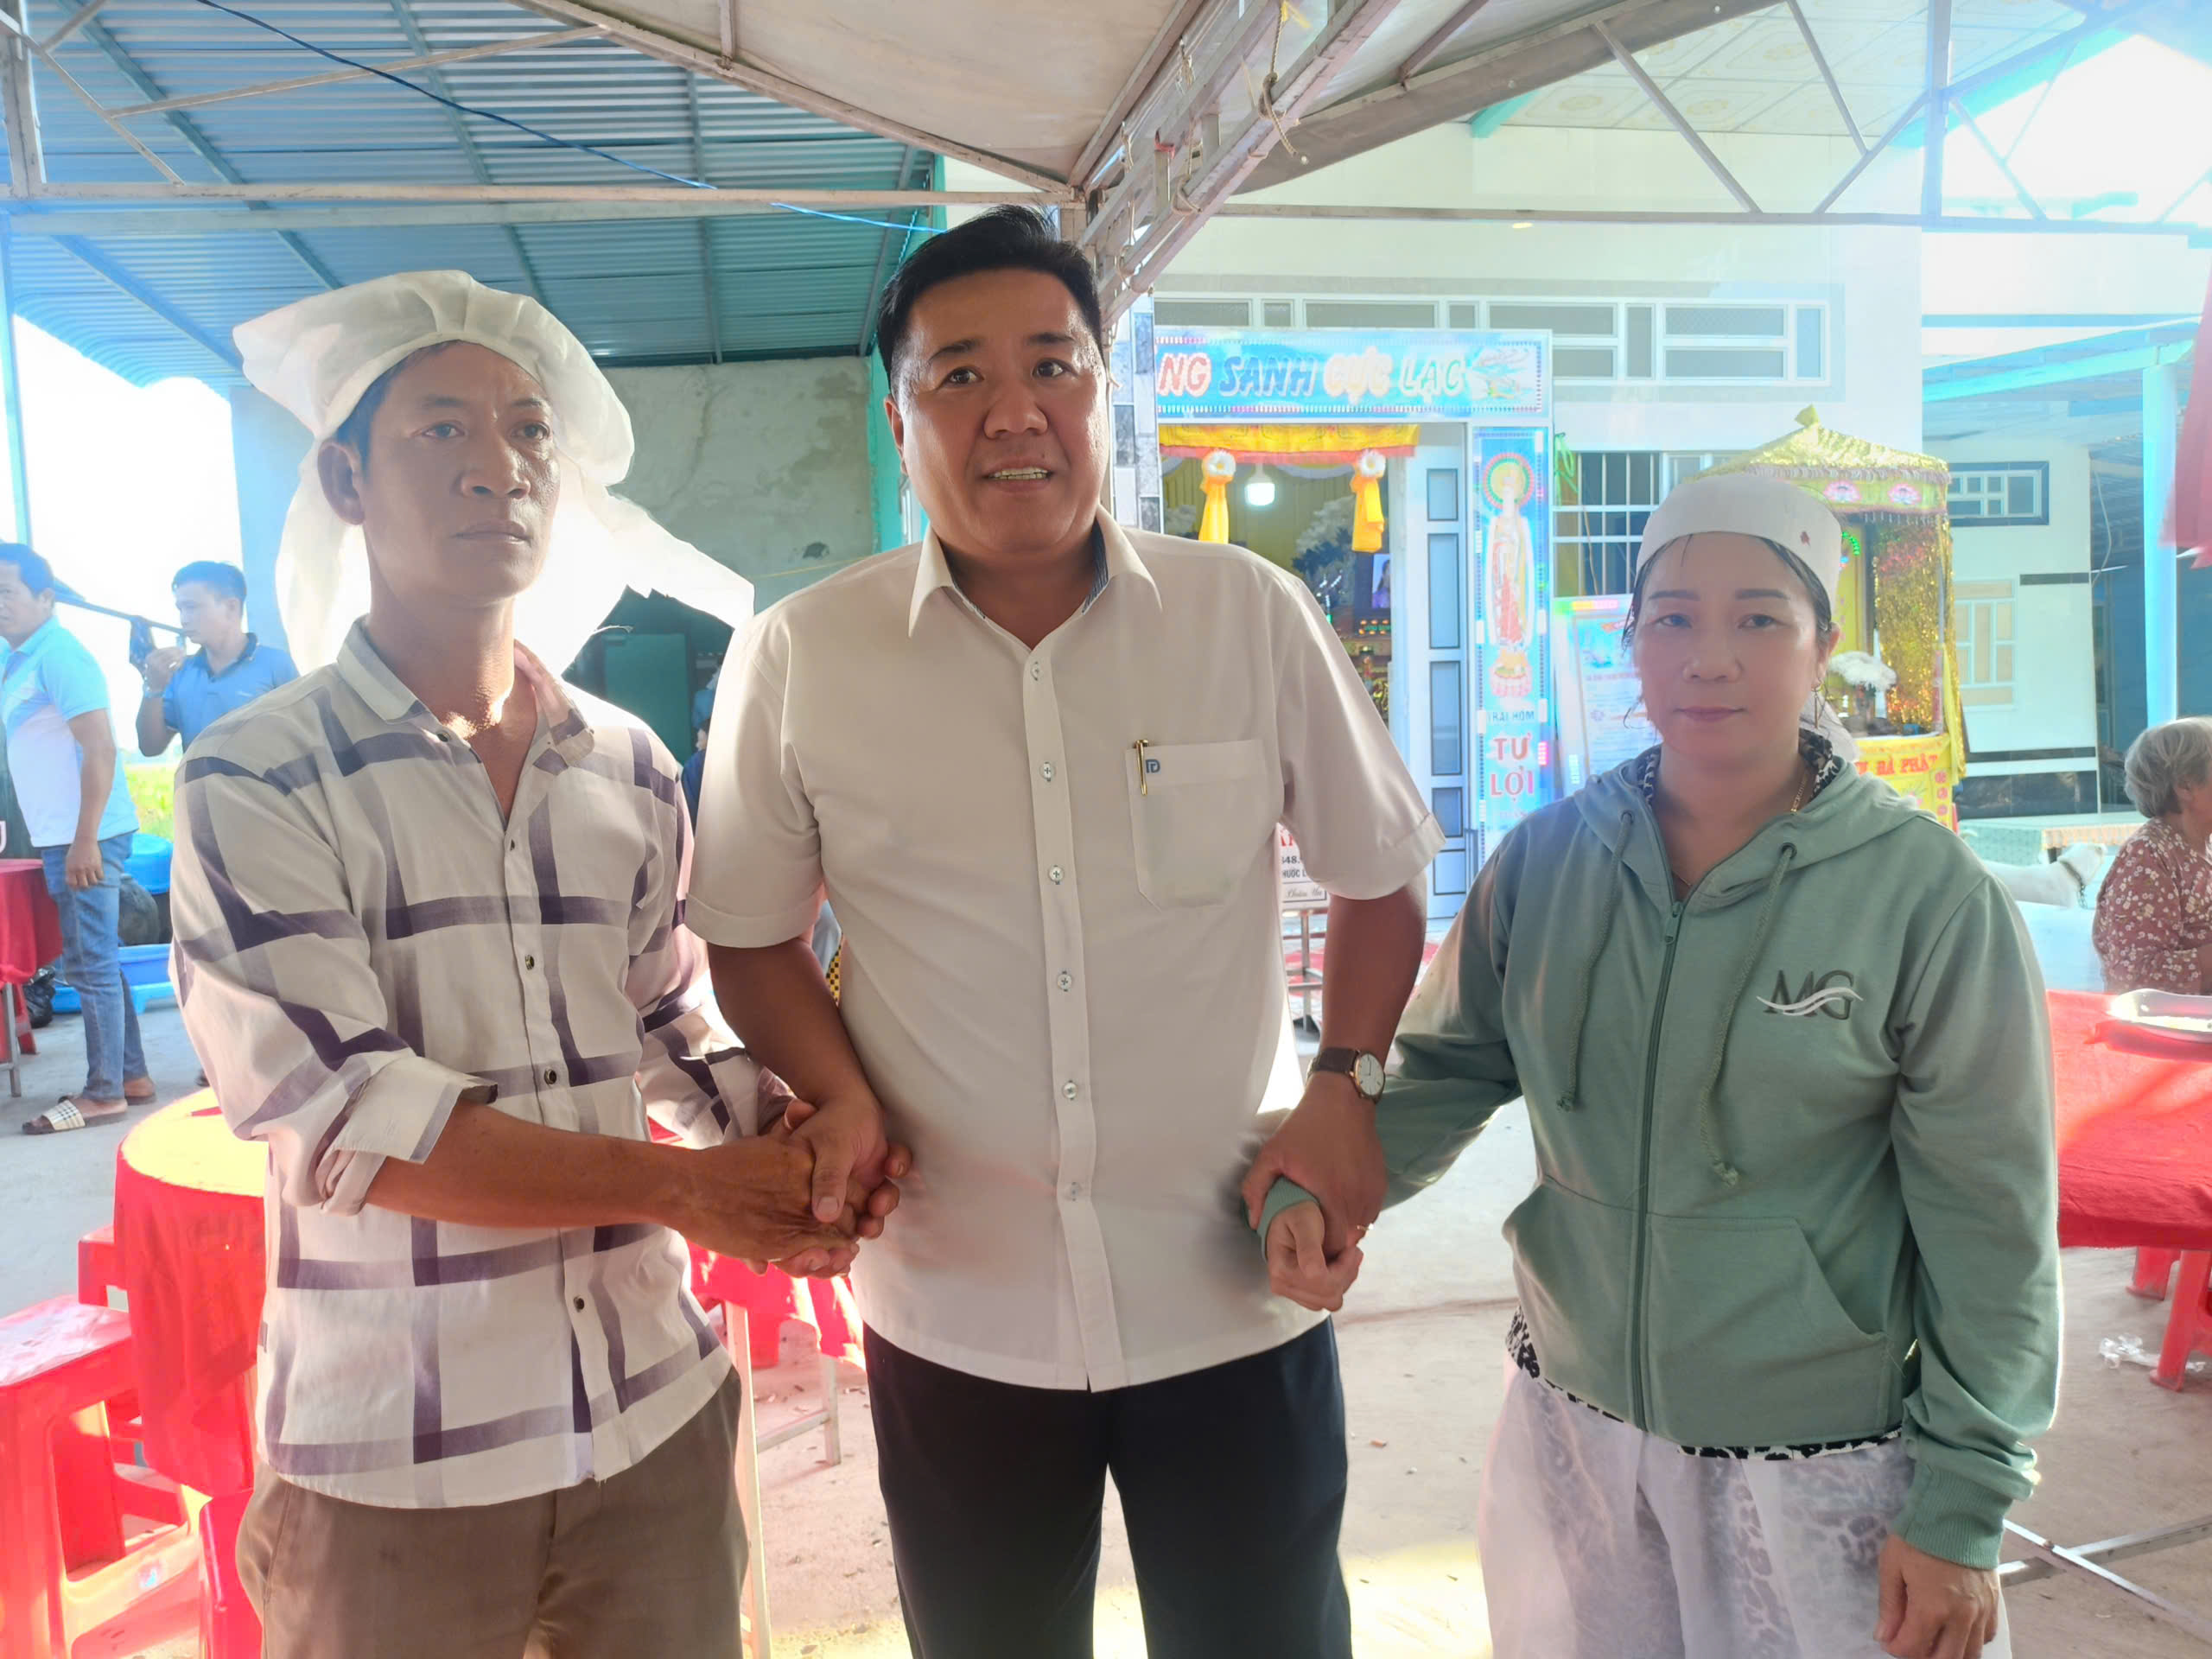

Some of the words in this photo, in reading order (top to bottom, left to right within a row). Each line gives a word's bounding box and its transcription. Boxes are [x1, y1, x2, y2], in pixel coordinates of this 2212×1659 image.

[1158, 353, 1211, 397] NG
[1219, 355, 1319, 397] SANH
[1763, 969, 1854, 1020] MG
